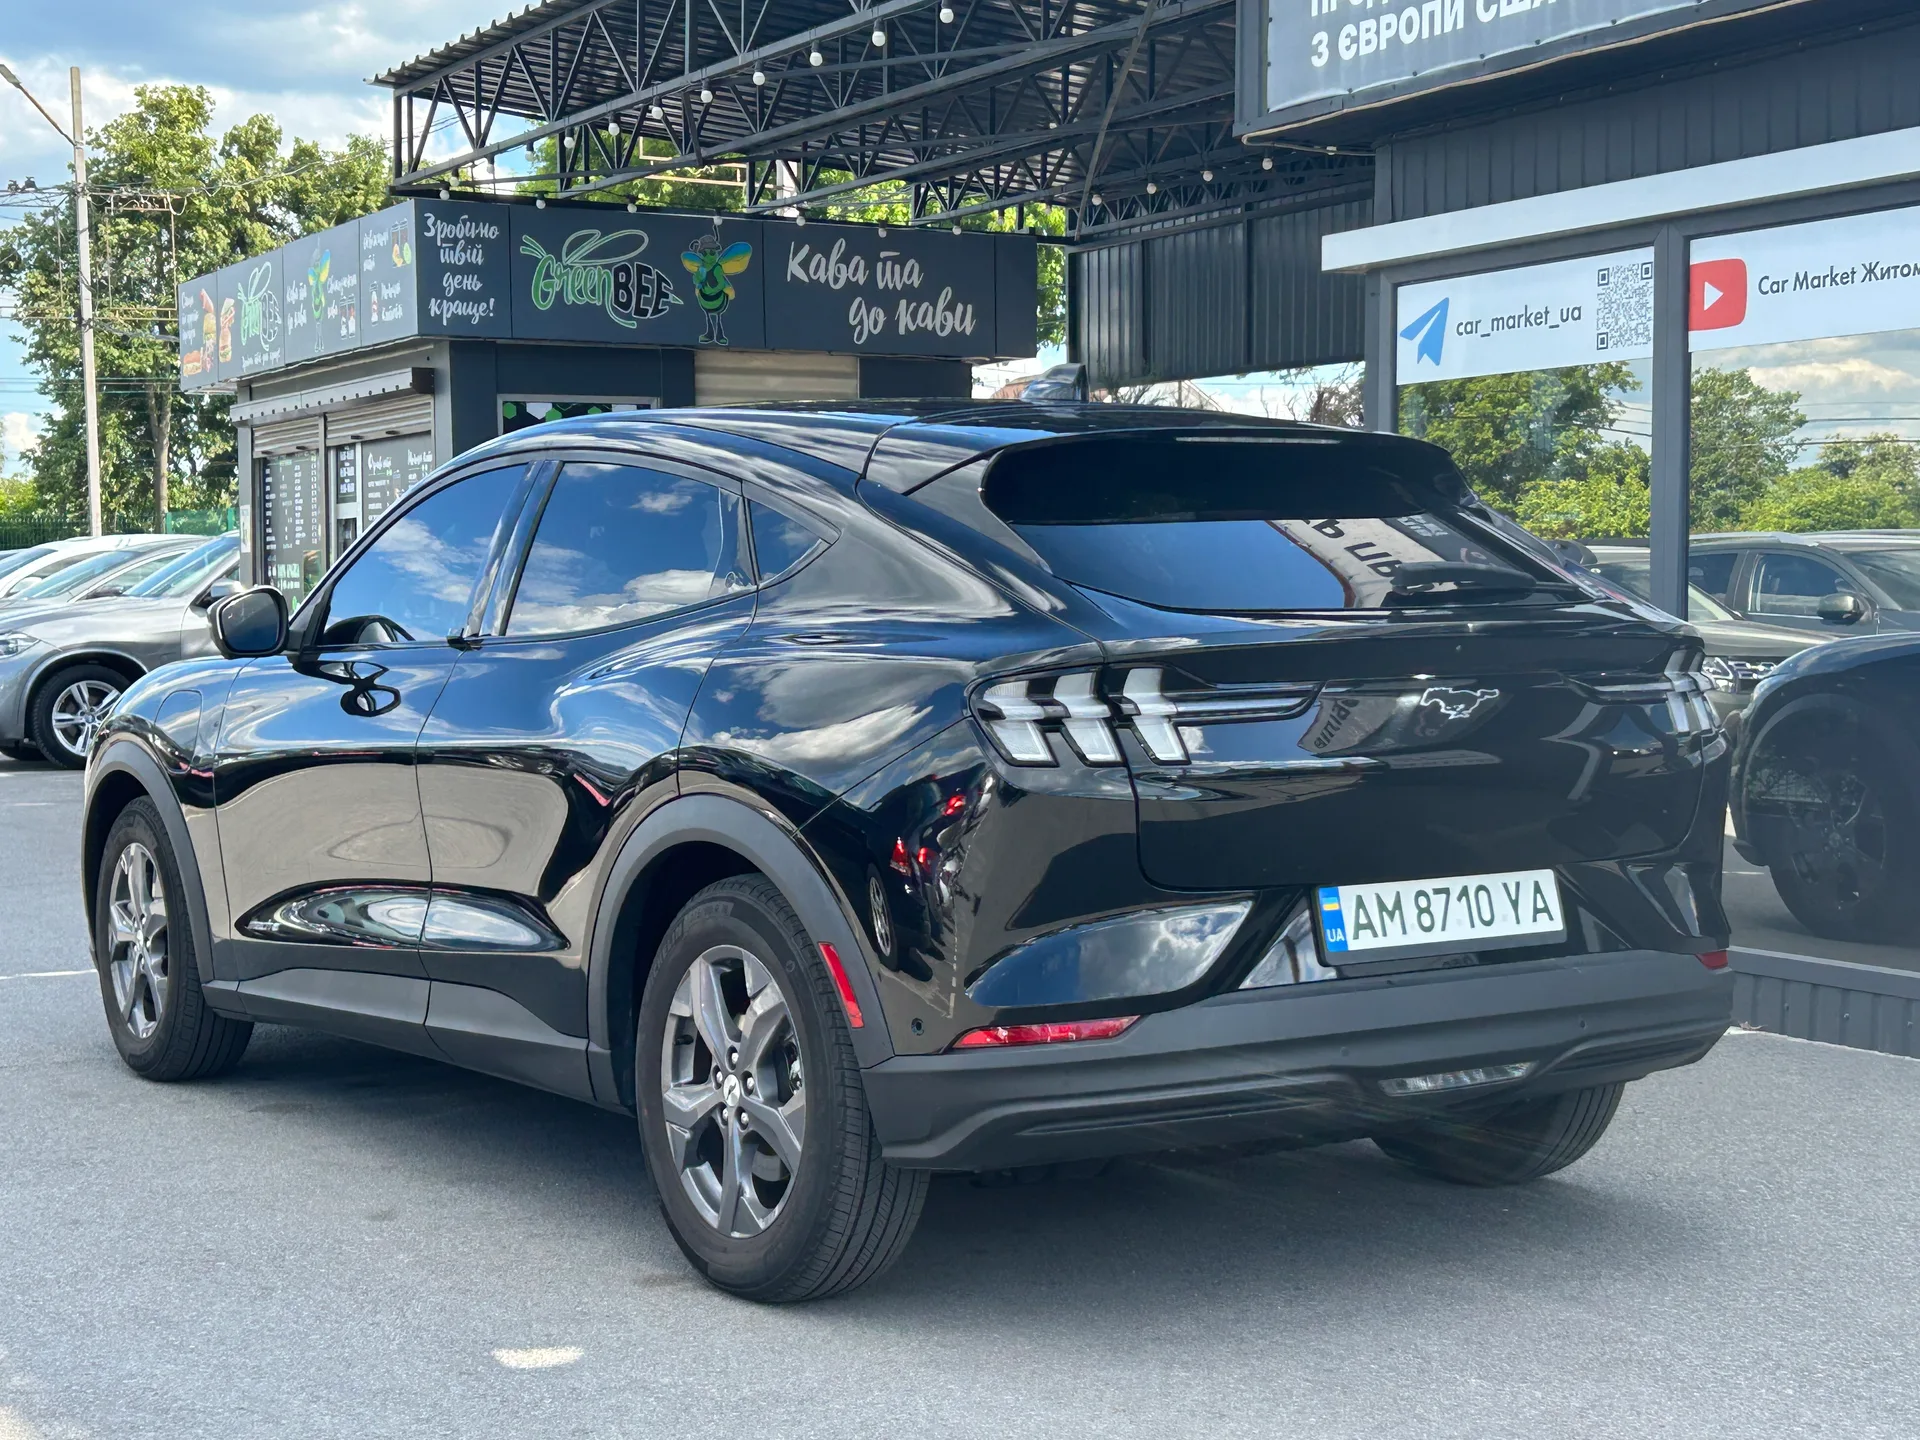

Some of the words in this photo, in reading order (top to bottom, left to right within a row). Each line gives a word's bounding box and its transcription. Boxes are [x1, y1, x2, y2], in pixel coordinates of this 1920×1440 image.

[1311, 31, 1329, 67] З
[1338, 0, 1464, 60] ЄВРОПИ
[424, 213, 499, 246] Зробимо
[440, 240, 484, 265] твій
[787, 238, 869, 289] Кава
[876, 251, 924, 290] та
[443, 272, 483, 297] день
[1758, 275, 1789, 295] Car
[1793, 265, 1857, 291] Market
[428, 298, 495, 326] краще!
[849, 297, 887, 344] до
[895, 287, 976, 337] кави
[1456, 304, 1582, 338] car_market_ua
[1352, 891, 1407, 940] AM
[1413, 884, 1496, 933] 8710
[1502, 880, 1555, 925] YA
[1327, 928, 1346, 943] UA
